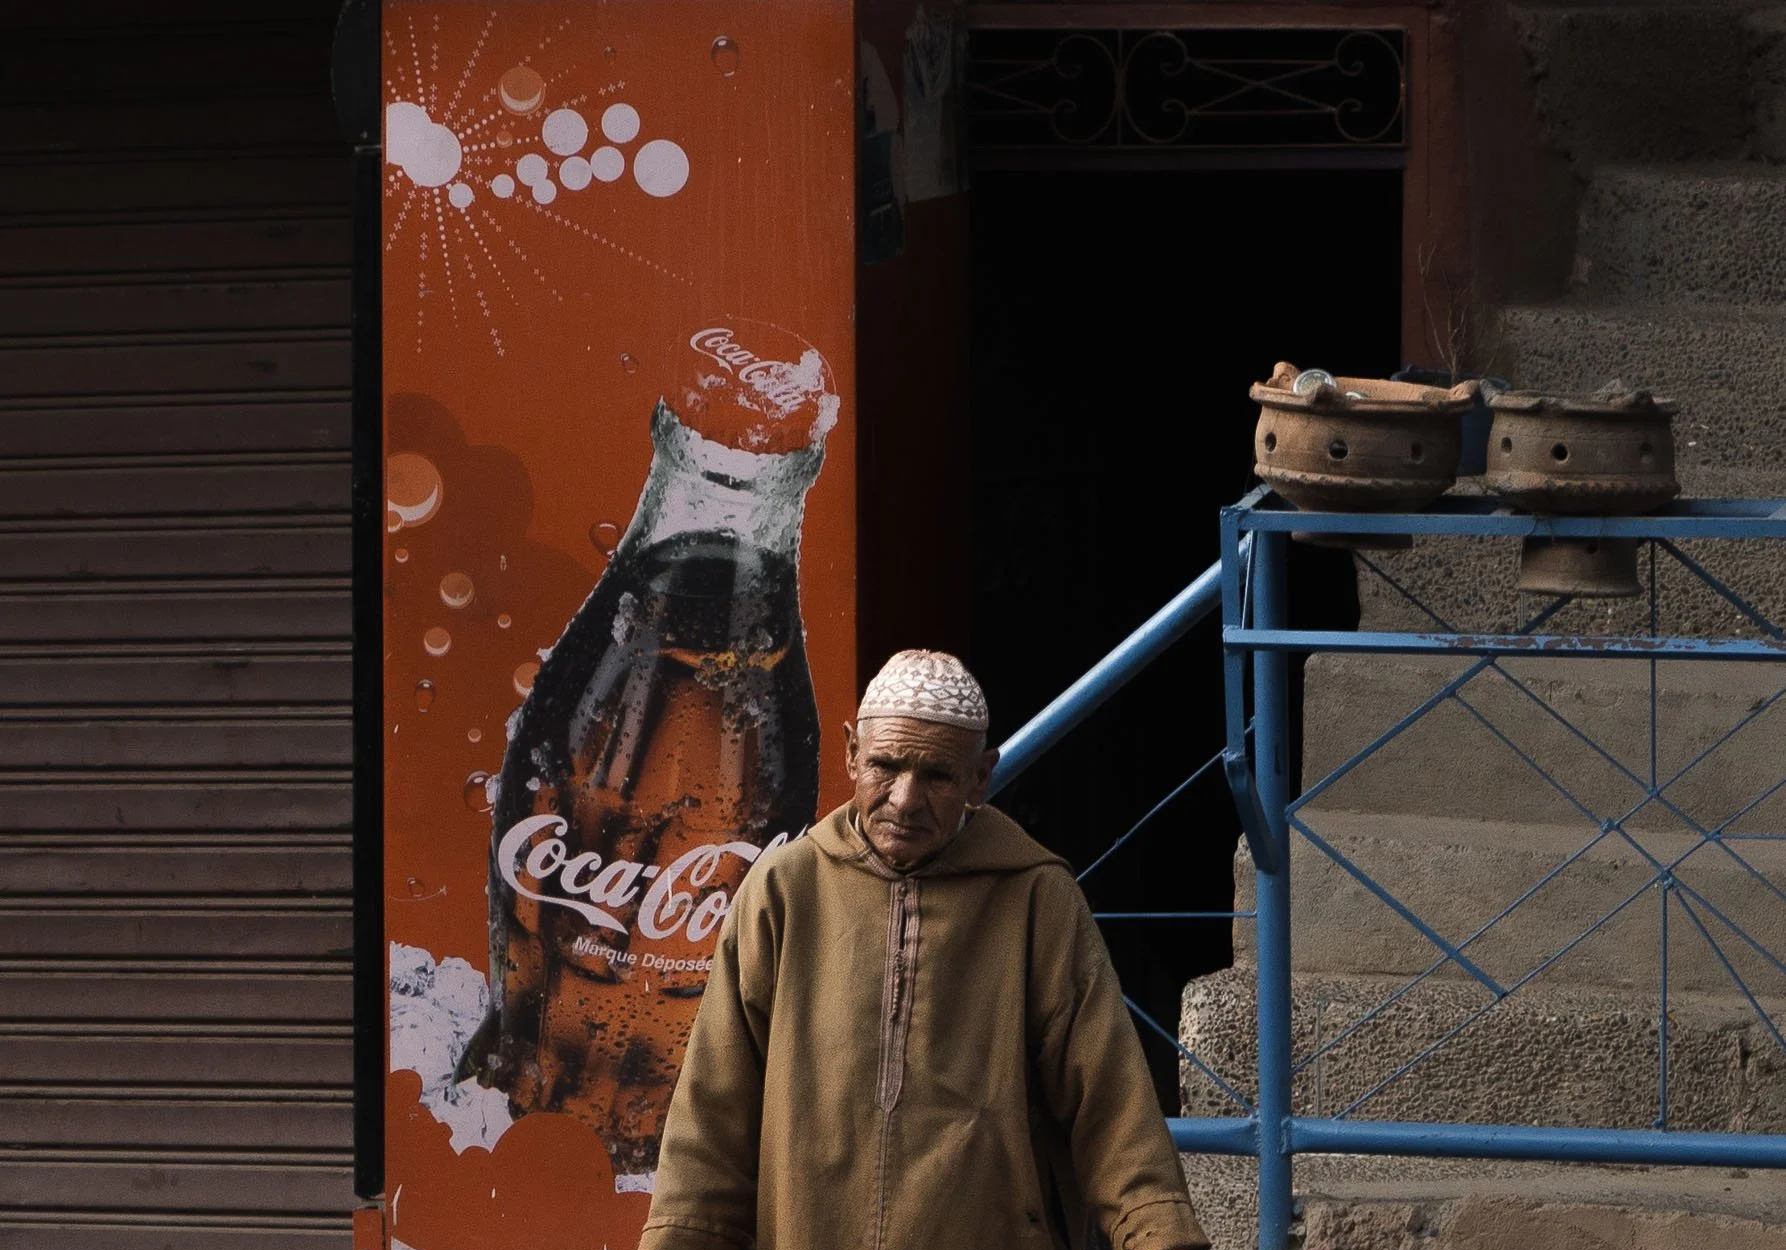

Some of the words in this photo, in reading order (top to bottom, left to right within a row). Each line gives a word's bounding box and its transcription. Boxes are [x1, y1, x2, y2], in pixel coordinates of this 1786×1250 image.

[499, 814, 807, 943] Coca-Co
[573, 936, 637, 967] Marque
[641, 953, 713, 972] Déposée
